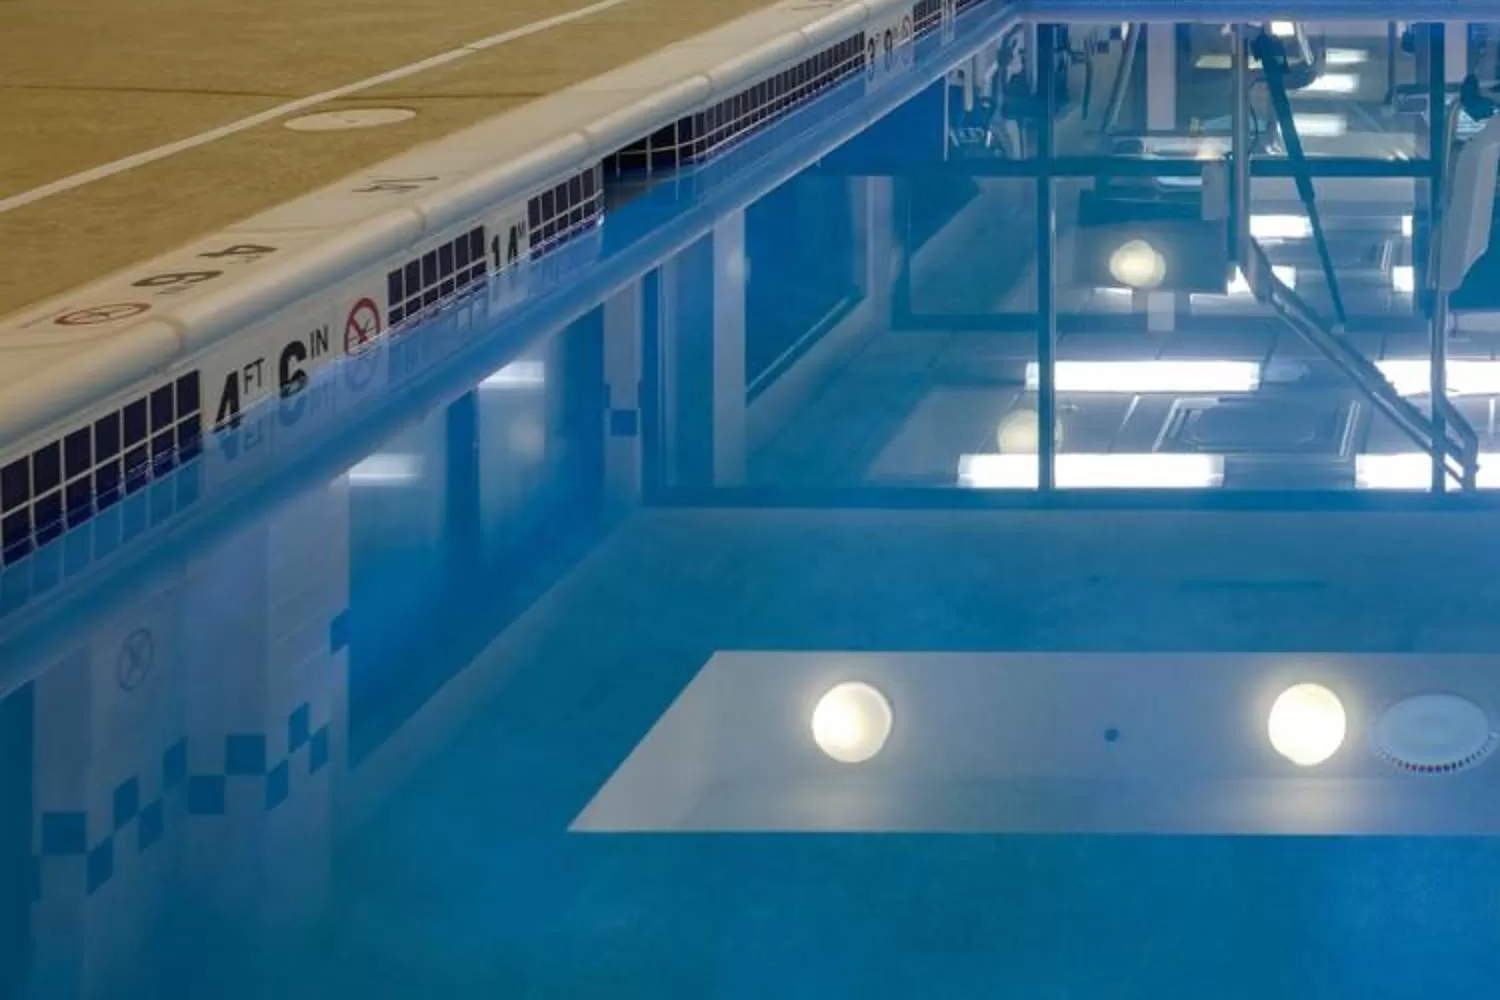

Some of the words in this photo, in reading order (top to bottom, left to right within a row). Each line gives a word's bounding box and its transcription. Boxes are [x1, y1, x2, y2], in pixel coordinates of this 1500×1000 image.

[243, 357, 265, 395] FT
[278, 340, 308, 399] 6
[309, 324, 329, 359] IN
